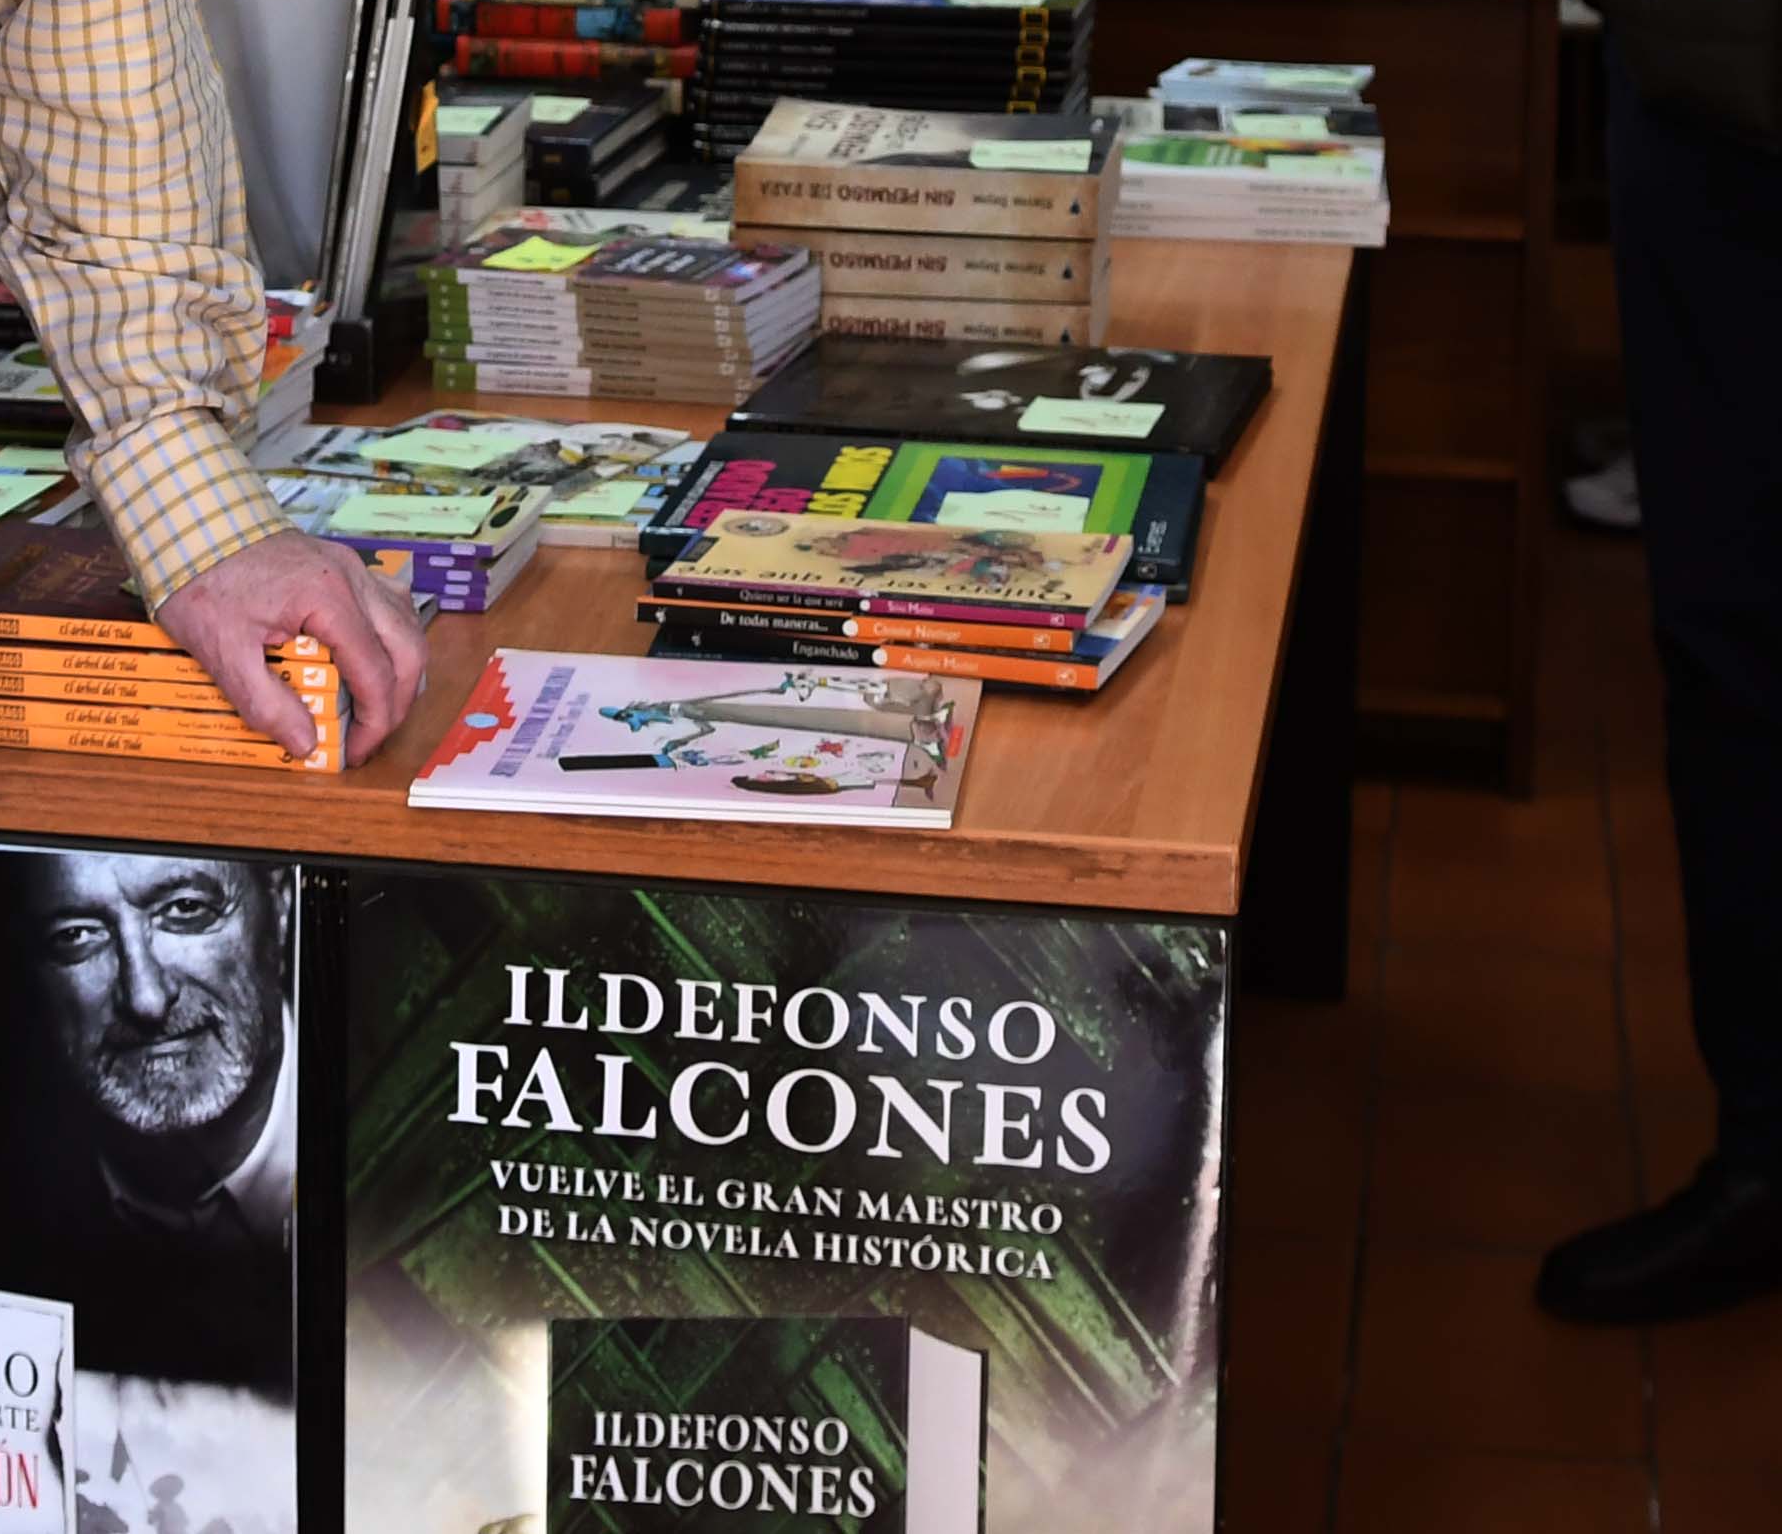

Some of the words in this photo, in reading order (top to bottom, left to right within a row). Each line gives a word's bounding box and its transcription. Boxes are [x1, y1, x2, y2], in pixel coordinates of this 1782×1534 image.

[837, 183, 919, 205] PERMISO
[925, 189, 956, 207] SIN
[720, 611, 735, 625] De
[739, 613, 769, 628] todas
[792, 640, 859, 660] Enganchado
[503, 965, 1056, 1064] ILDEFONSO
[447, 1041, 1111, 1174] FALCONES
[489, 1160, 646, 1202] VUELVE
[658, 1175, 705, 1207] EL
[717, 1179, 842, 1219] GRAN
[857, 1188, 1063, 1235] MAESTRO
[498, 1205, 554, 1237] DE
[566, 1211, 617, 1244] LA
[629, 1215, 800, 1261] NOVELA
[813, 1232, 1054, 1281] HISTÓRICA
[593, 1411, 849, 1456] ILDEFONSO
[569, 1454, 877, 1519] FALCONES
